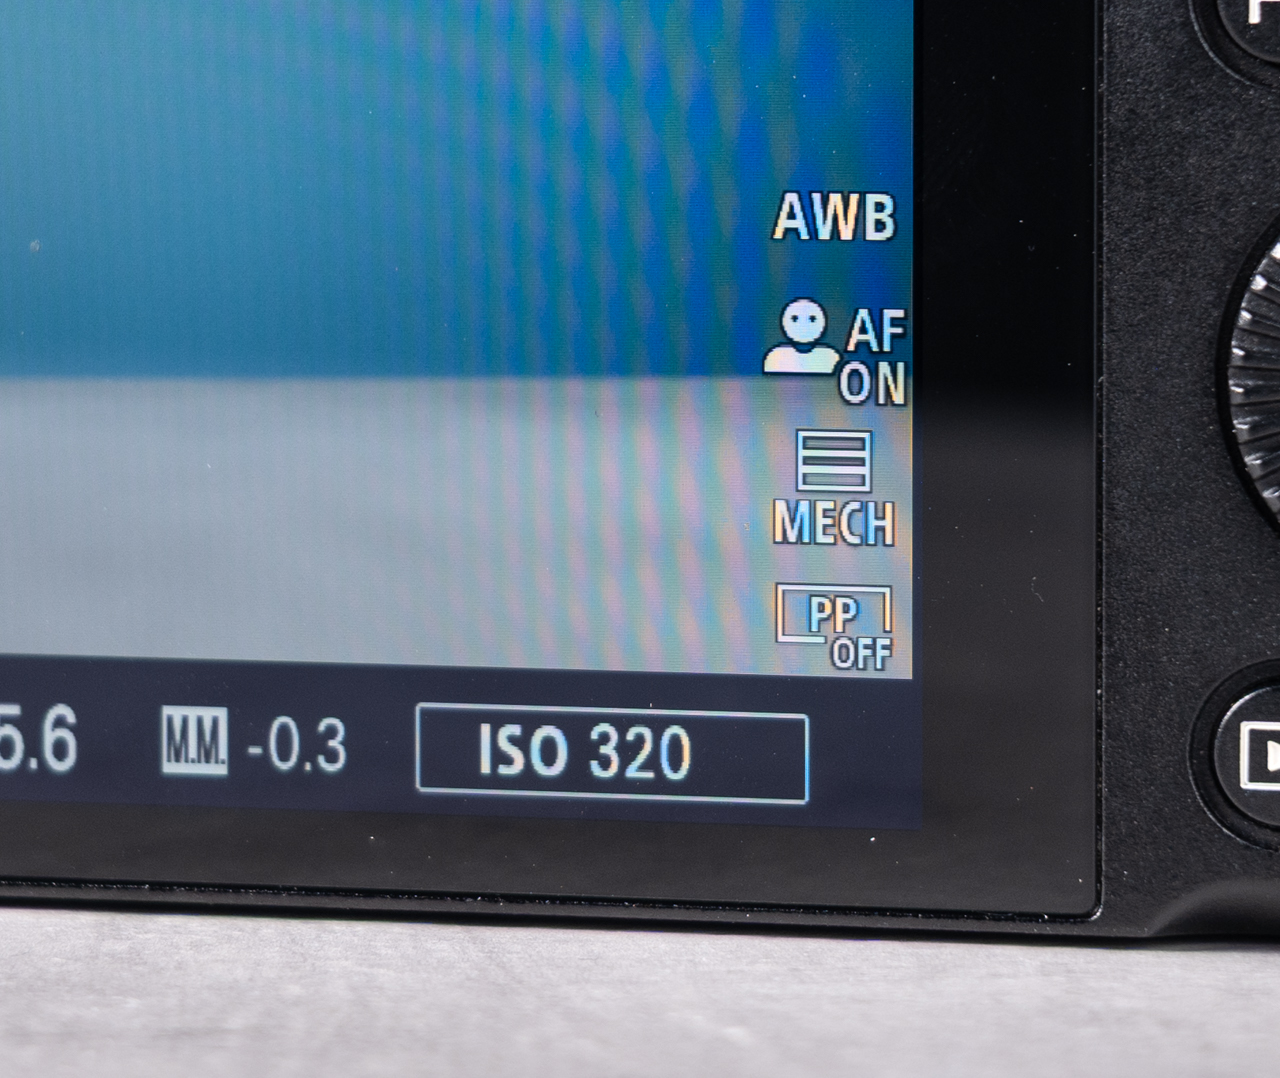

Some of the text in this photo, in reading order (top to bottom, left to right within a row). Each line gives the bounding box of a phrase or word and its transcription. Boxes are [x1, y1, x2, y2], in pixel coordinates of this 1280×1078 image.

[772, 191, 896, 242] AWB
[846, 308, 906, 353] AF
[839, 360, 906, 406] ON
[773, 498, 895, 547] MECH
[808, 594, 859, 634] PP
[830, 635, 893, 671] OFF
[165, 712, 228, 765] M.M.
[247, 715, 348, 772] -0.3
[478, 721, 692, 780] ISO 320
